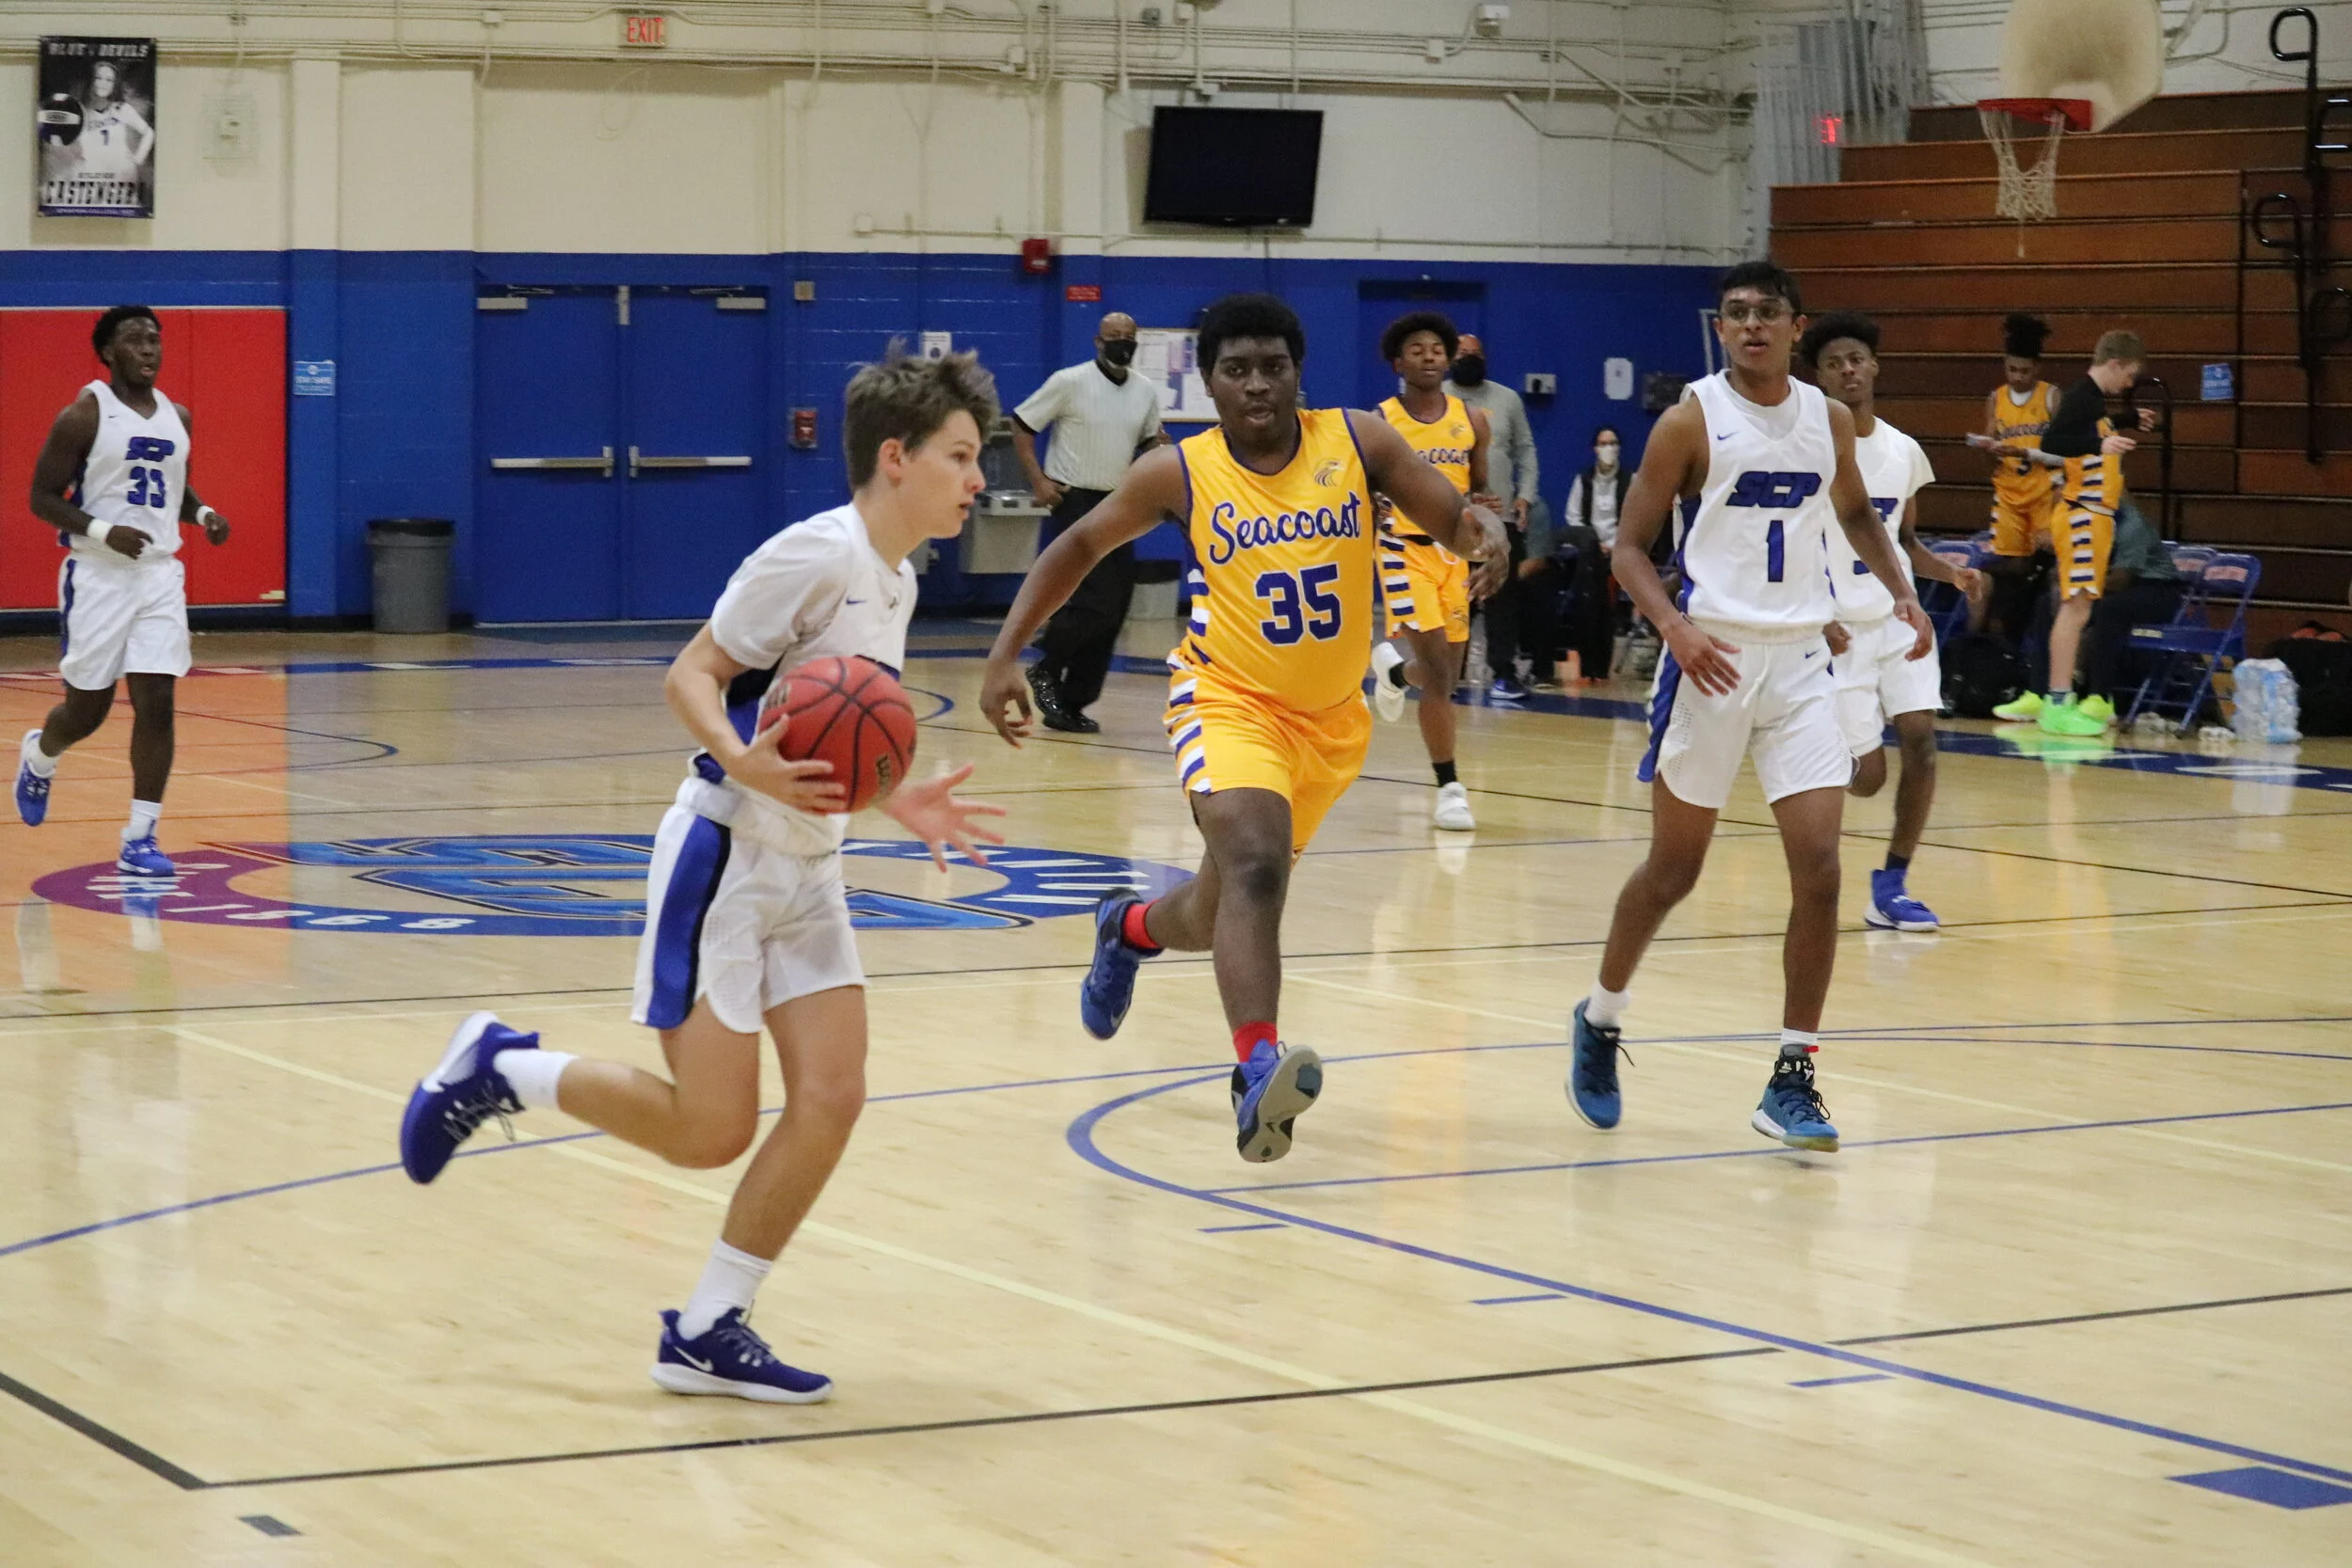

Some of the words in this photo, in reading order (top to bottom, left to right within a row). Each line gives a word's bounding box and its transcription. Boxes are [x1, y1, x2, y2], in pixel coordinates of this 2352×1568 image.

[627, 16, 664, 43] EXIT
[127, 466, 166, 509] 33
[1725, 470, 1822, 509] SCP
[1209, 491, 1362, 565] Seacoast
[1765, 519, 1785, 583] 1
[1254, 562, 1343, 646] 35
[163, 903, 476, 929] 1868
